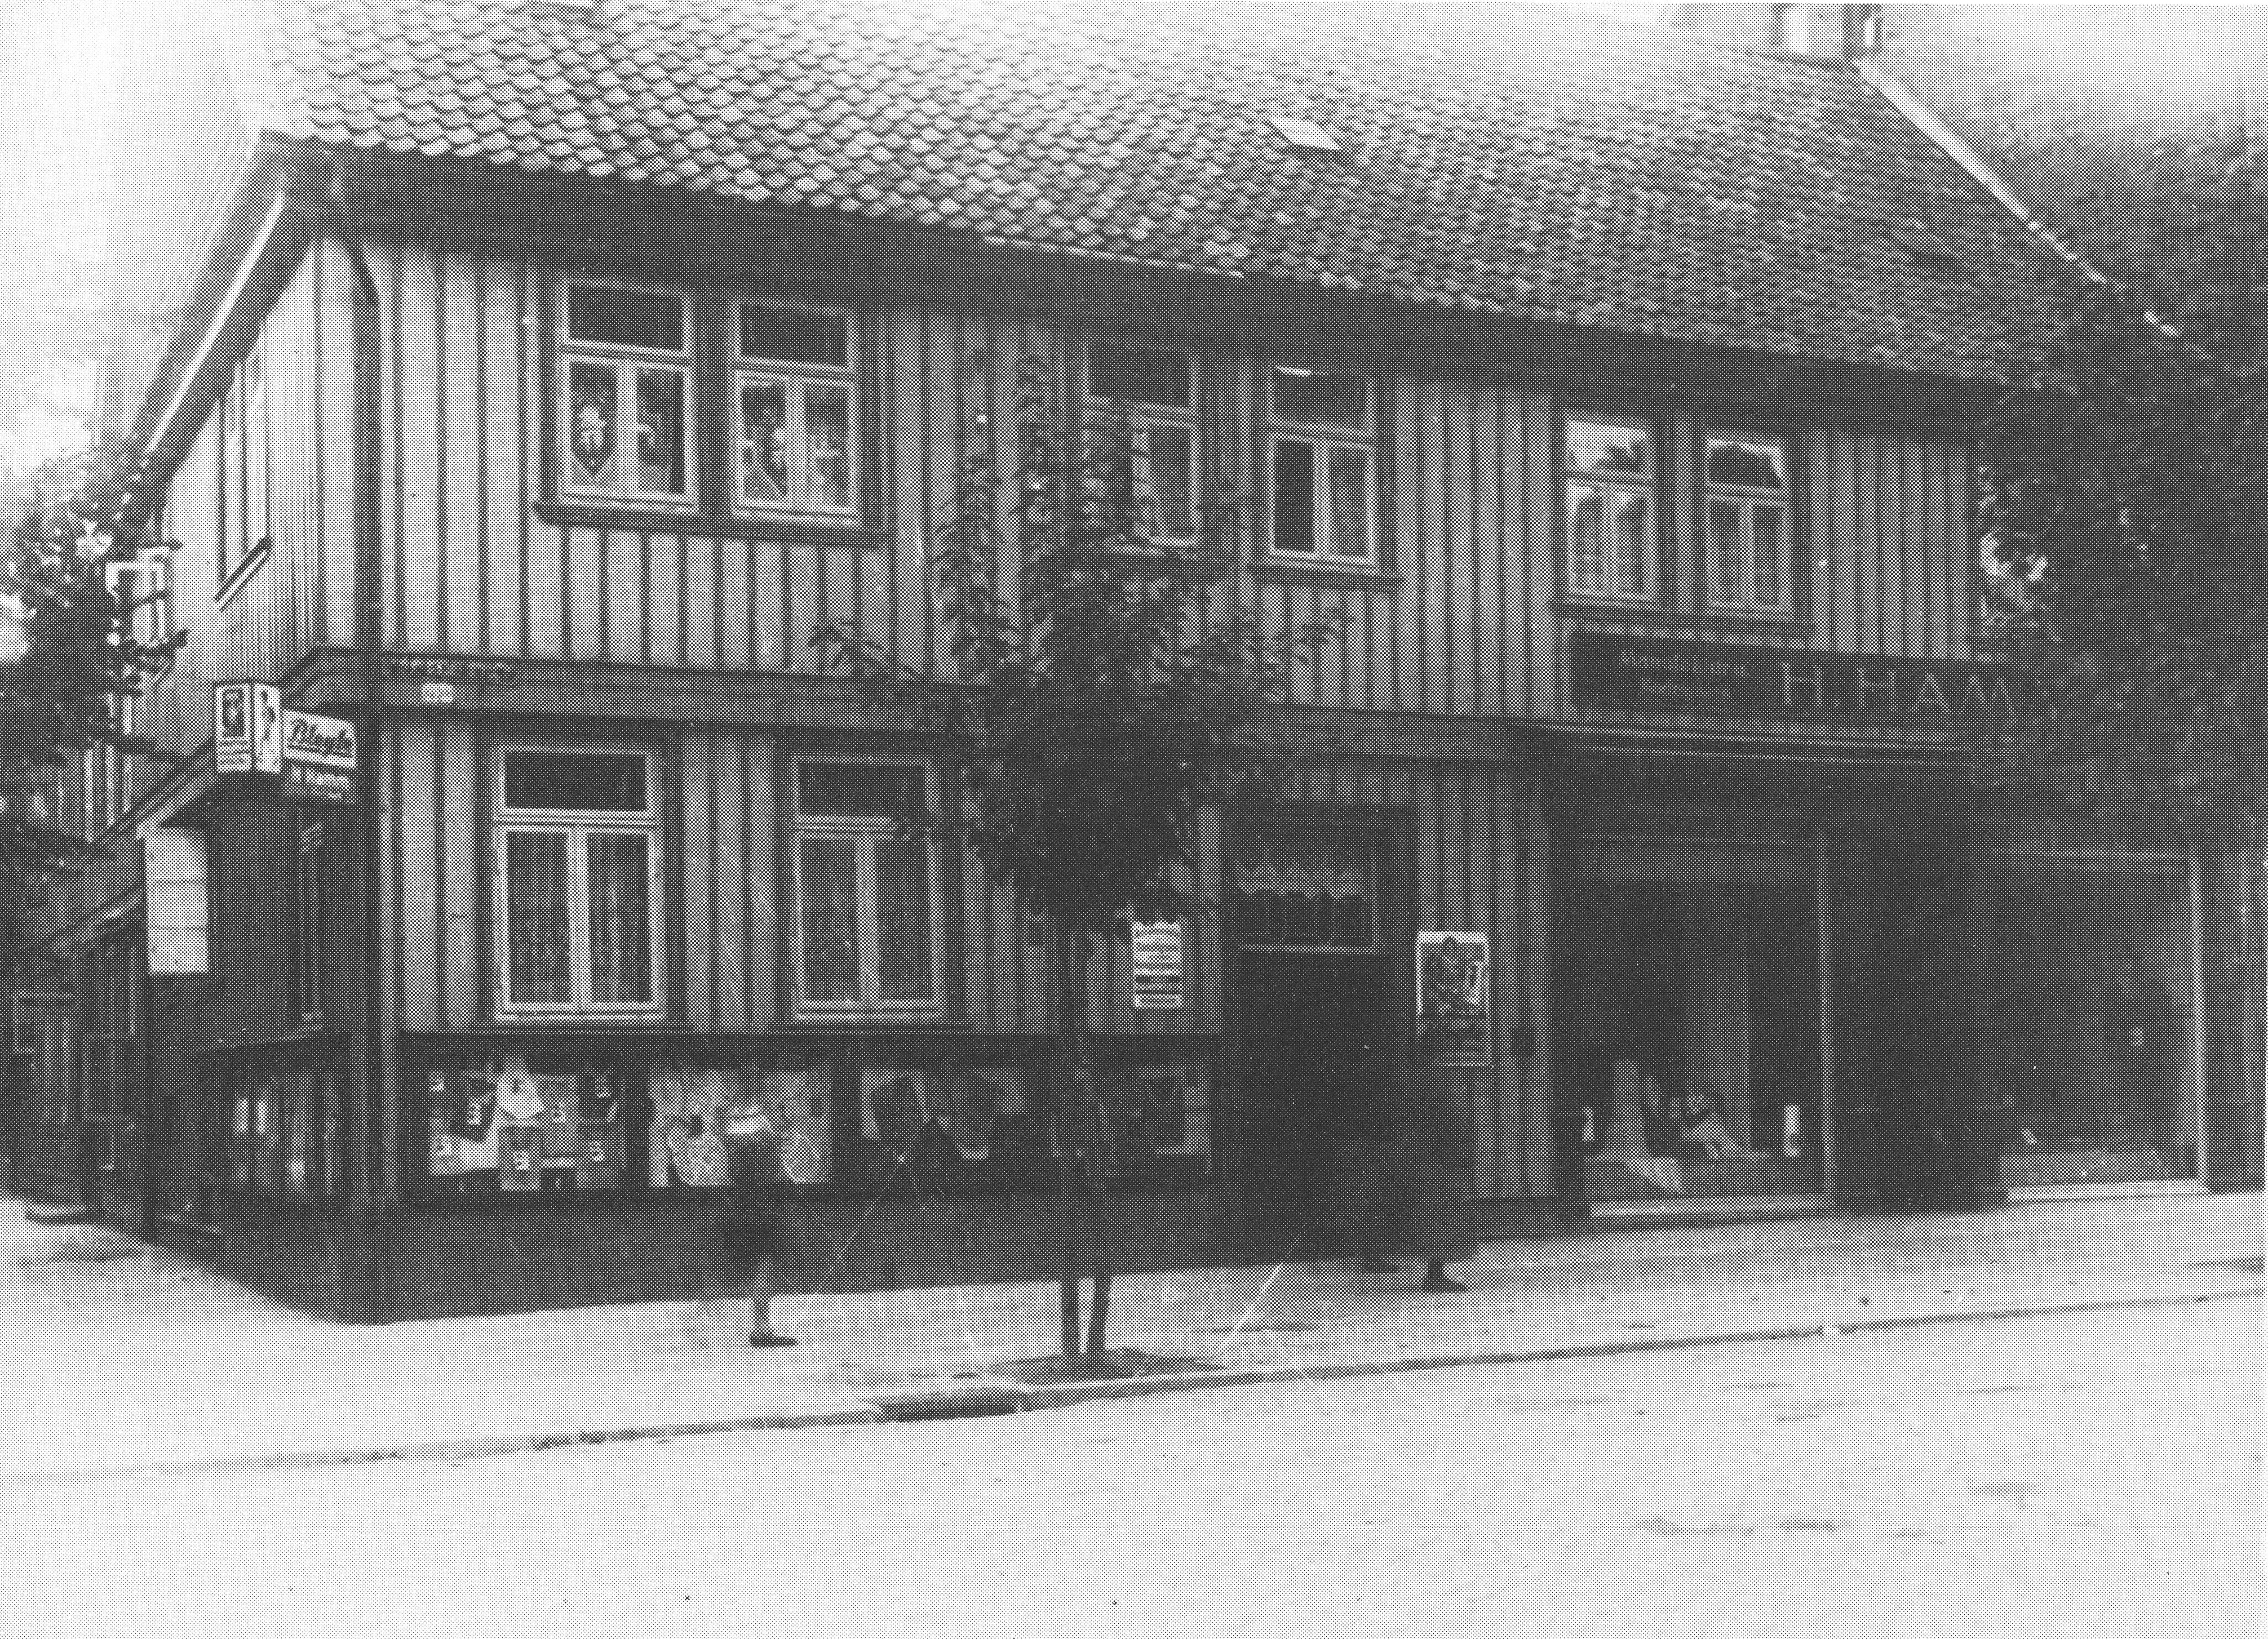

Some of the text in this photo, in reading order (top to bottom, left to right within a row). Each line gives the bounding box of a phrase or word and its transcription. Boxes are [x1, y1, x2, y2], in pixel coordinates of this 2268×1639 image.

[1780, 662, 2017, 718] H. HAM
[287, 718, 353, 757] Bleyle
